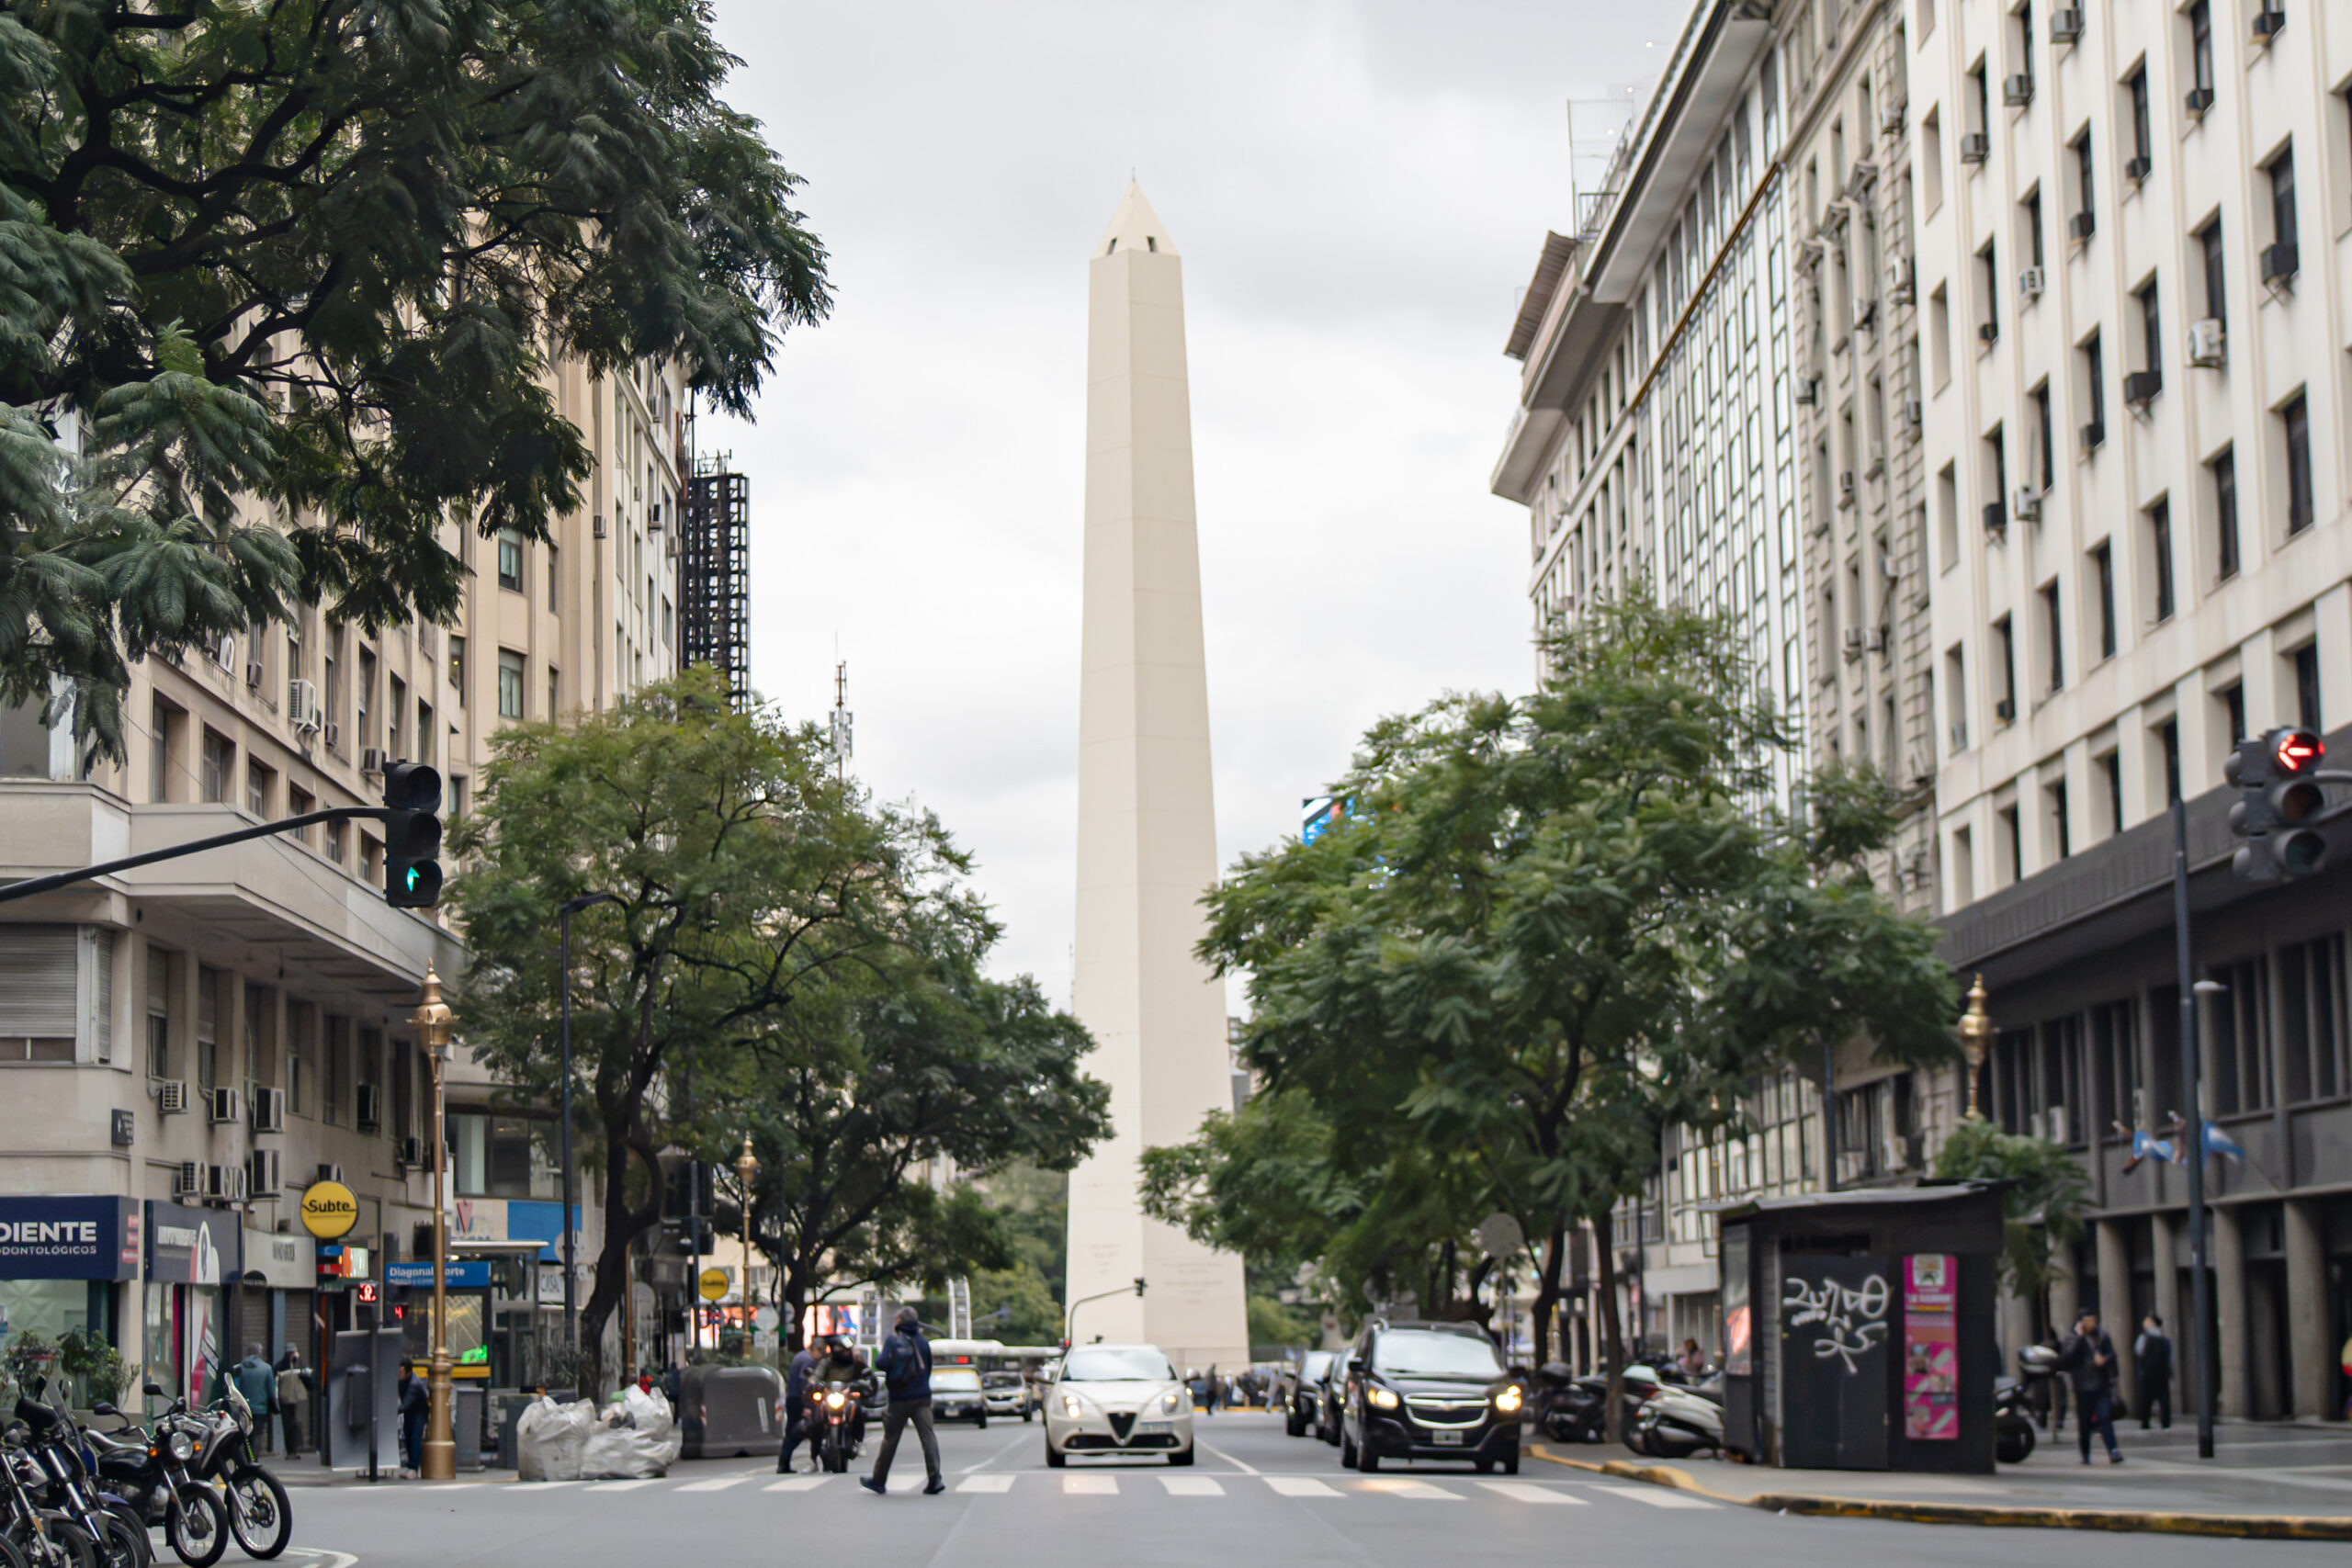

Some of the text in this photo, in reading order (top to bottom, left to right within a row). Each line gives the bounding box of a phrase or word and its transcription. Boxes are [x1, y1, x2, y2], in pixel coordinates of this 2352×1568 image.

[308, 1199, 350, 1213] Subte
[0, 1246, 96, 1256] DONTOLÓGICOS
[389, 1267, 434, 1279] Diagonal
